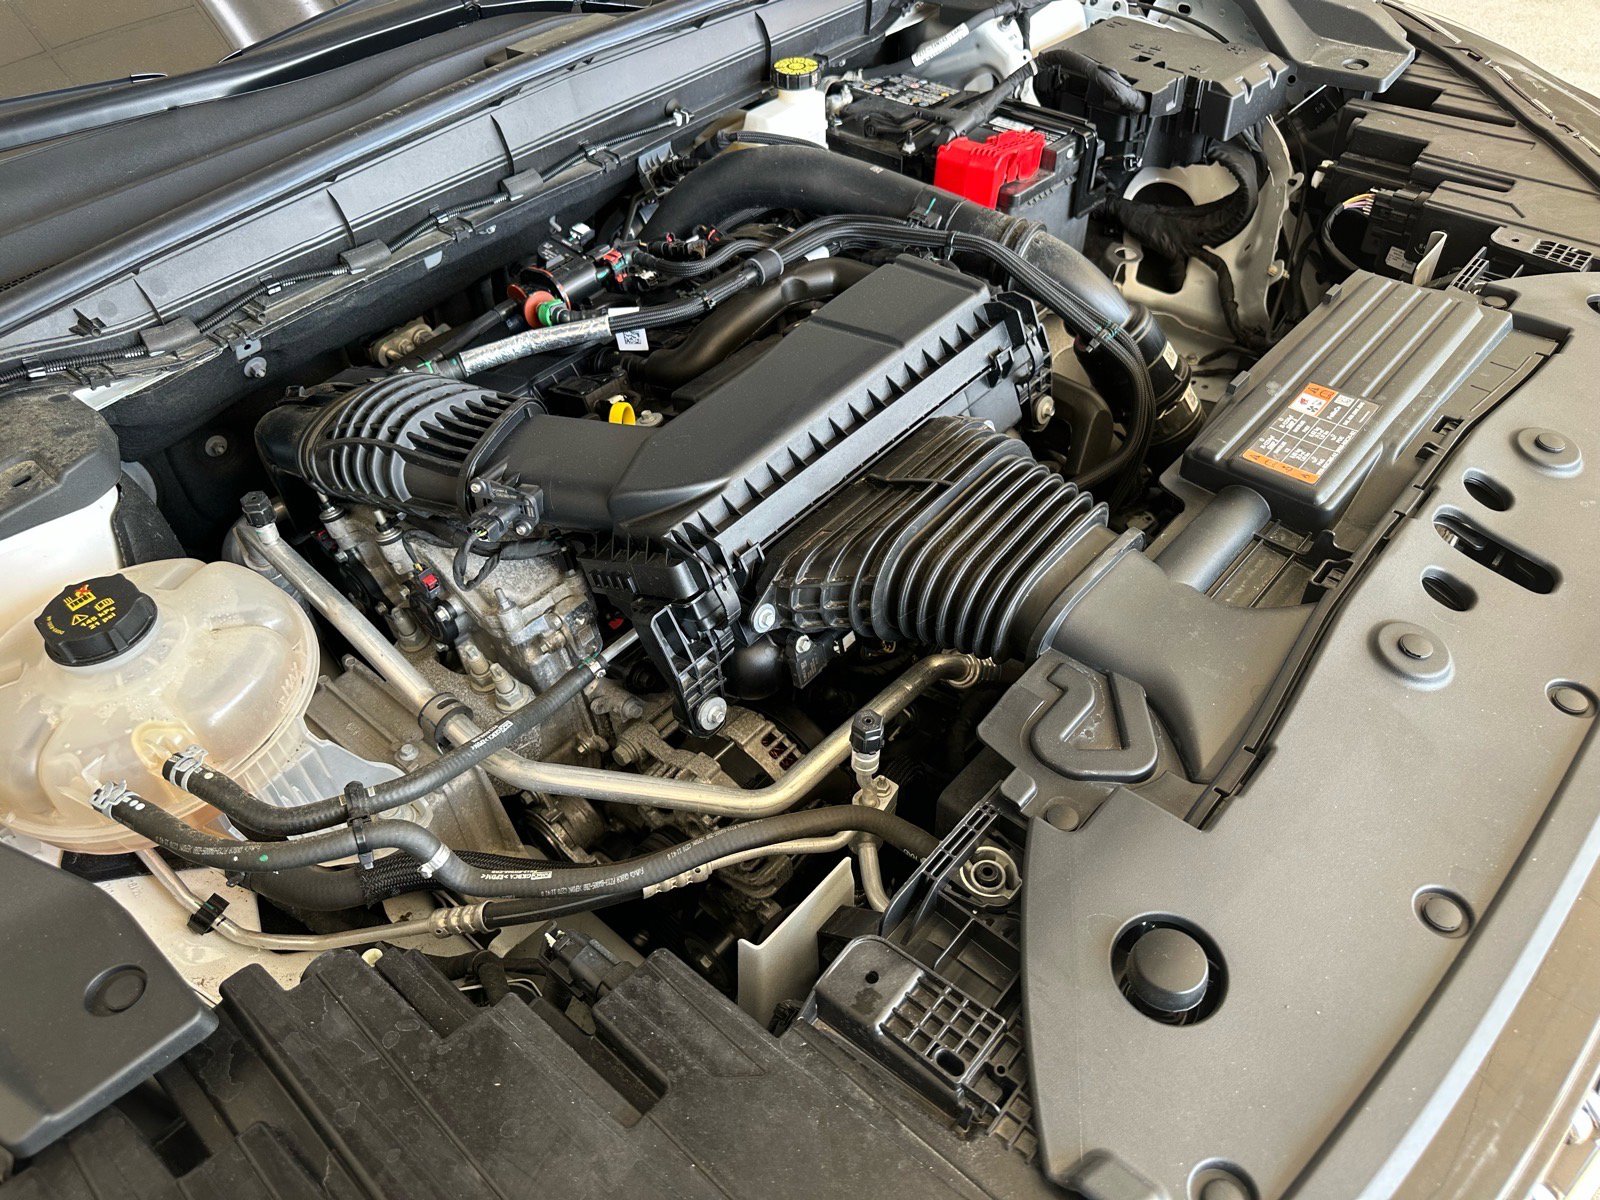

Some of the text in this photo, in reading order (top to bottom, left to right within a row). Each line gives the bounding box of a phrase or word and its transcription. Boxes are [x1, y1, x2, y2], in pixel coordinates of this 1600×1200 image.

[80, 606, 116, 627] 145 kPa
[88, 612, 117, 631] 21 psi
